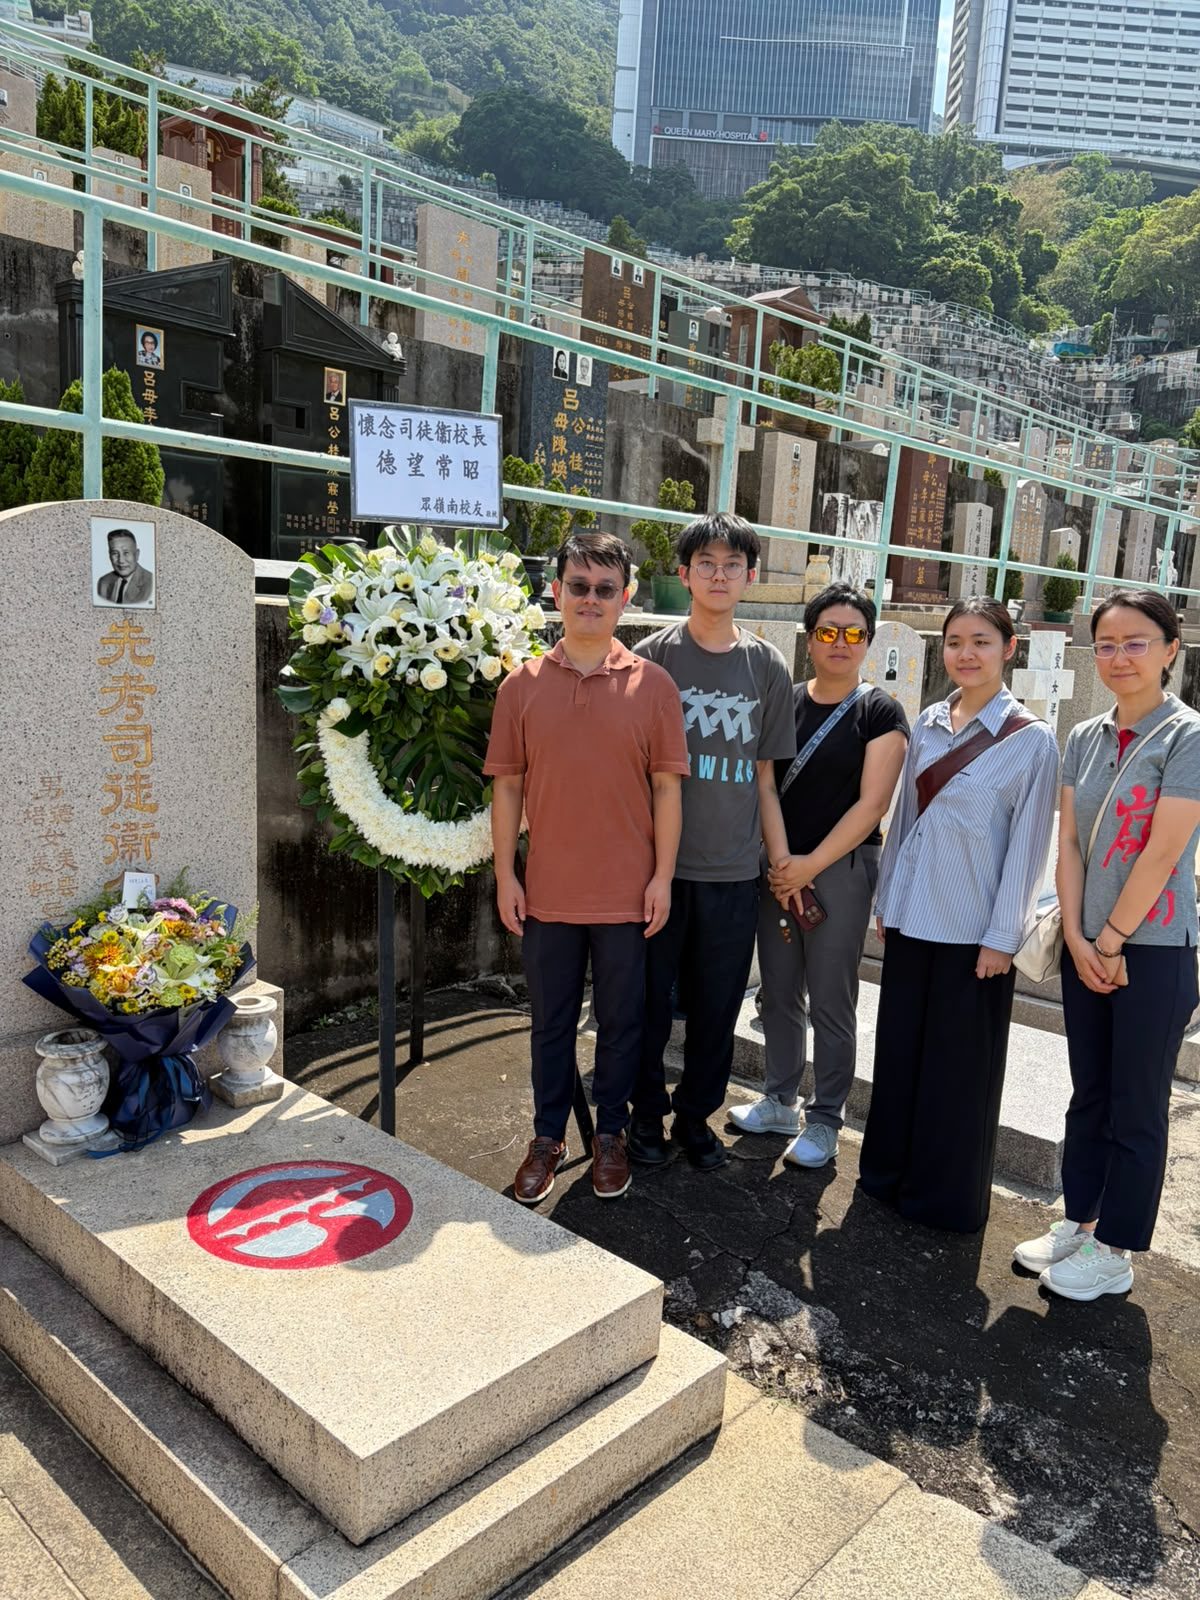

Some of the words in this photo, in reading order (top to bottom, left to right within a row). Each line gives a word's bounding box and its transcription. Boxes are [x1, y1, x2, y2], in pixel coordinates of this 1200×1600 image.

[664, 126, 693, 136] QUEEN
[694, 129, 719, 138] MARY
[719, 131, 758, 141] HOSPITAL
[376, 448, 480, 481] 德望常昭
